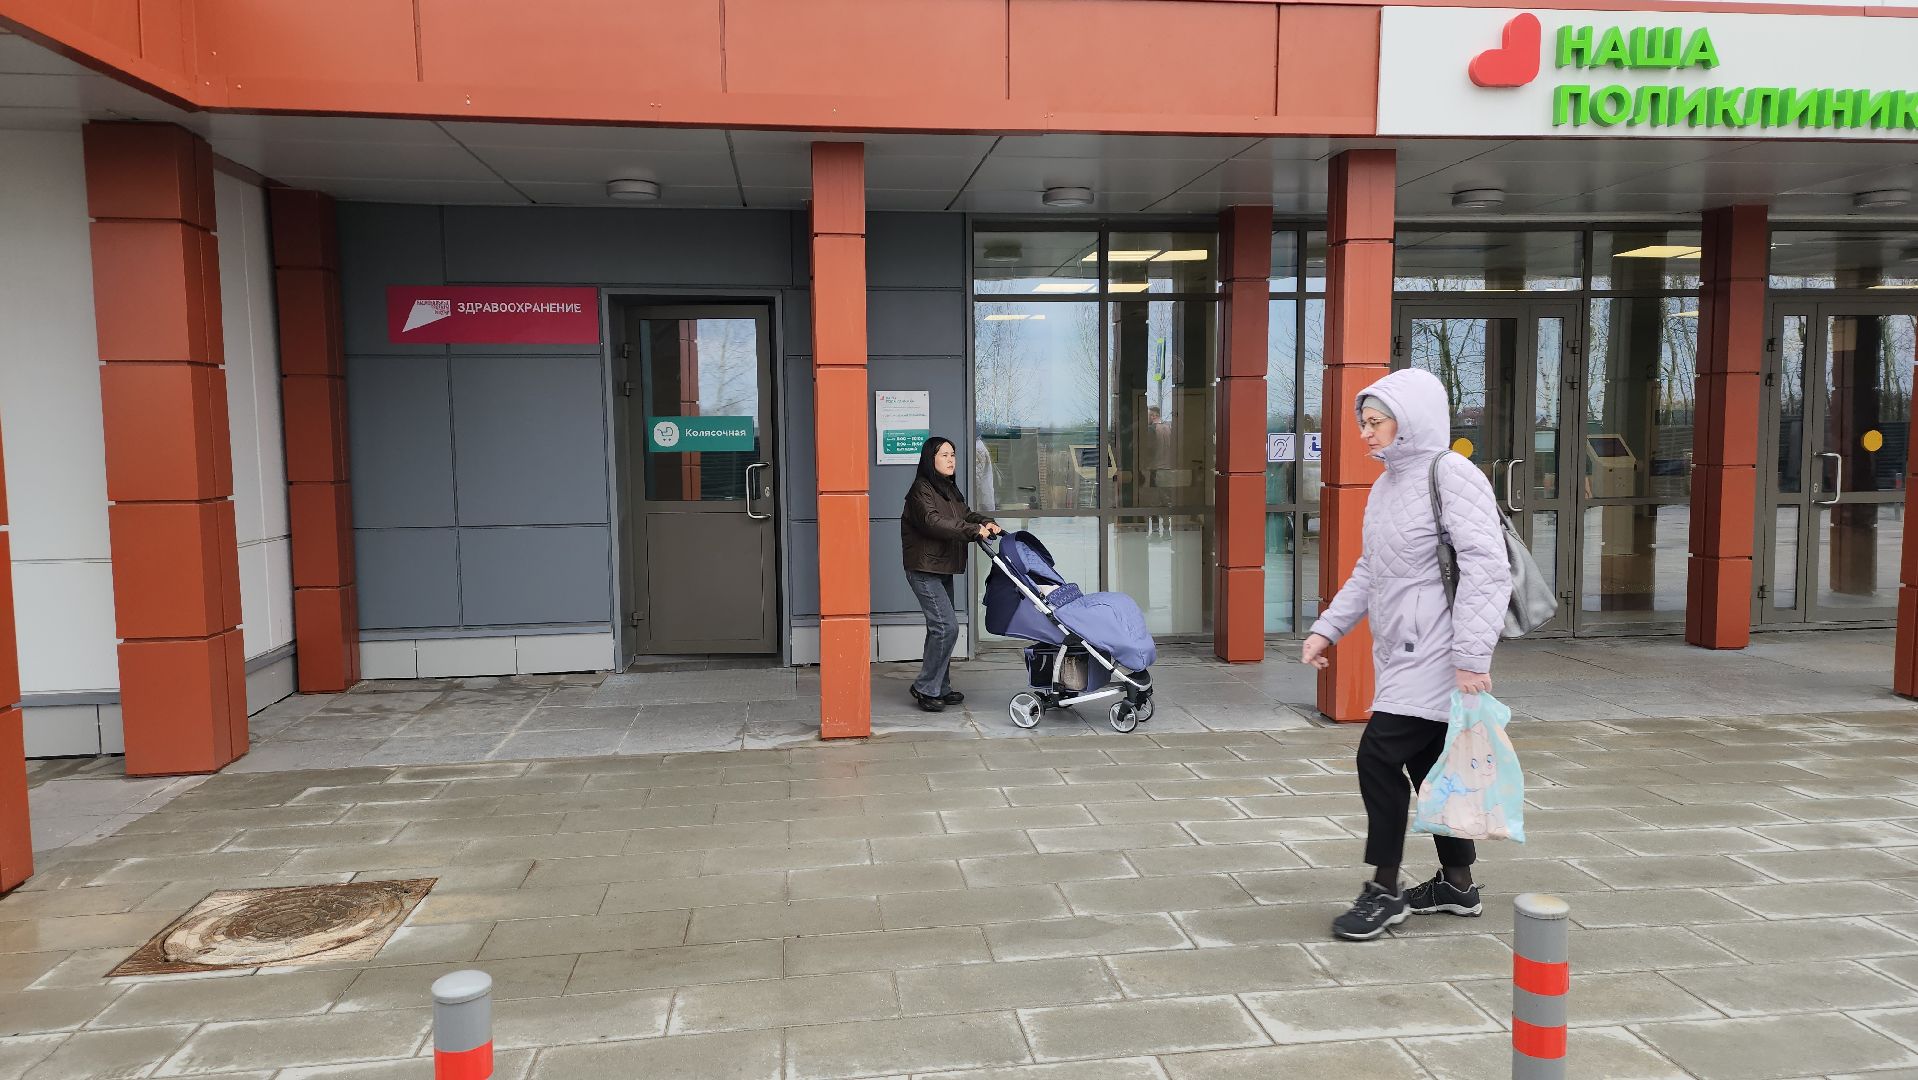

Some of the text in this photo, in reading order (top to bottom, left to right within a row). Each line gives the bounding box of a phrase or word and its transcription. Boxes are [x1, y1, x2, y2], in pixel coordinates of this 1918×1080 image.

[1555, 25, 1720, 70] НАША
[457, 302, 582, 315] ЗДРАВООХРАНЕНИЕ
[685, 428, 747, 437] Колясочная
